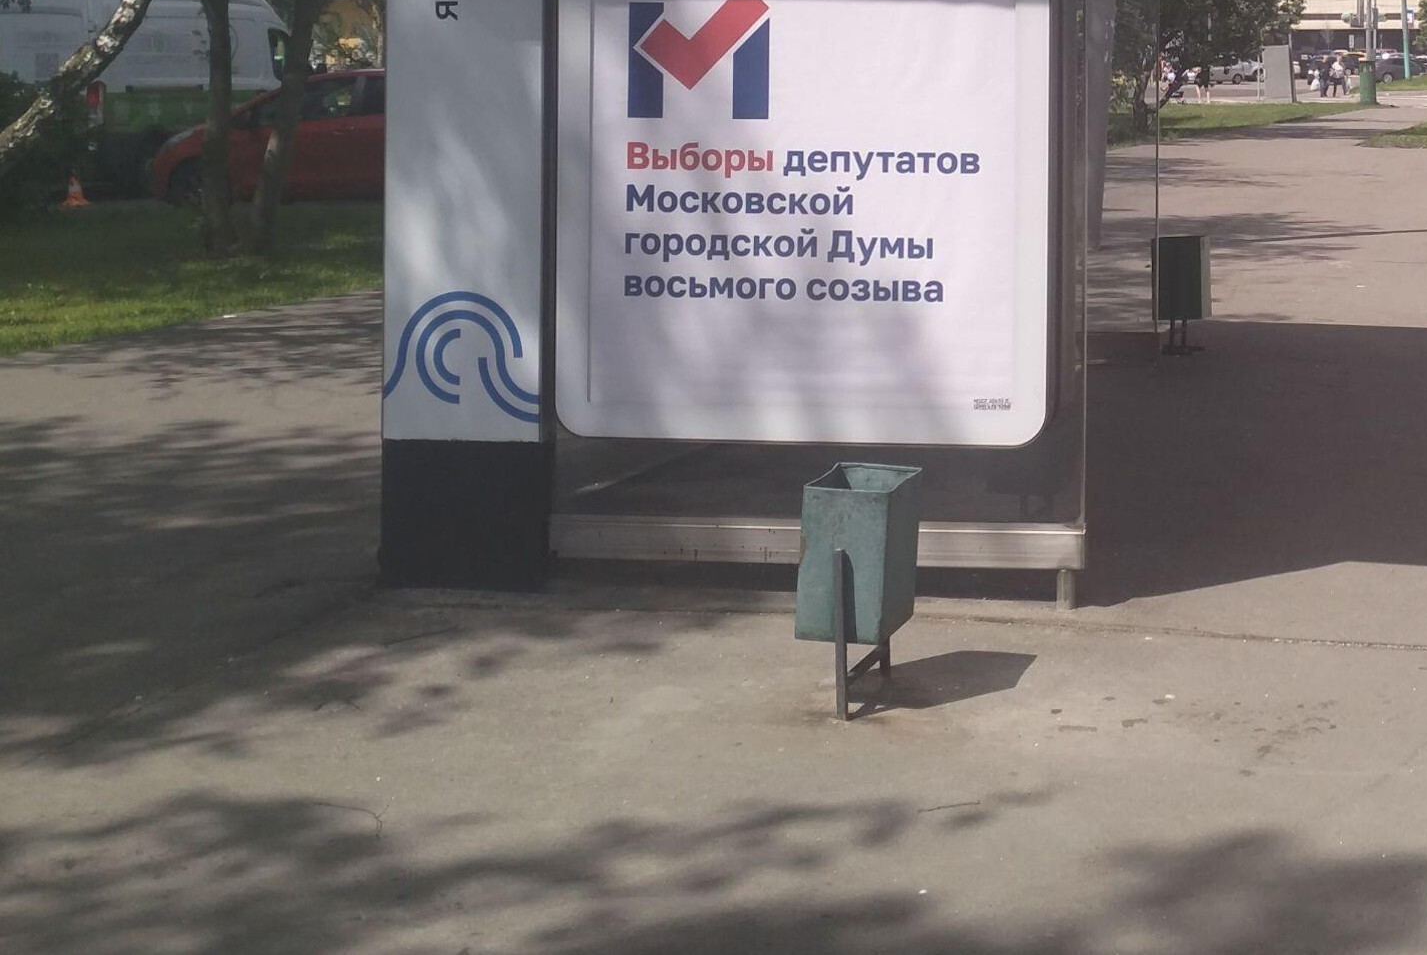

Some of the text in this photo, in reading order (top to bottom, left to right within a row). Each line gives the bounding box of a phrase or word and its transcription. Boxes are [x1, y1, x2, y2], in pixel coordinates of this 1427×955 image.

[626, 142, 981, 181] Выборы депутатов
[626, 183, 854, 216] Московской
[624, 229, 934, 266] городской Думы
[623, 275, 944, 303] восьмого созыва
